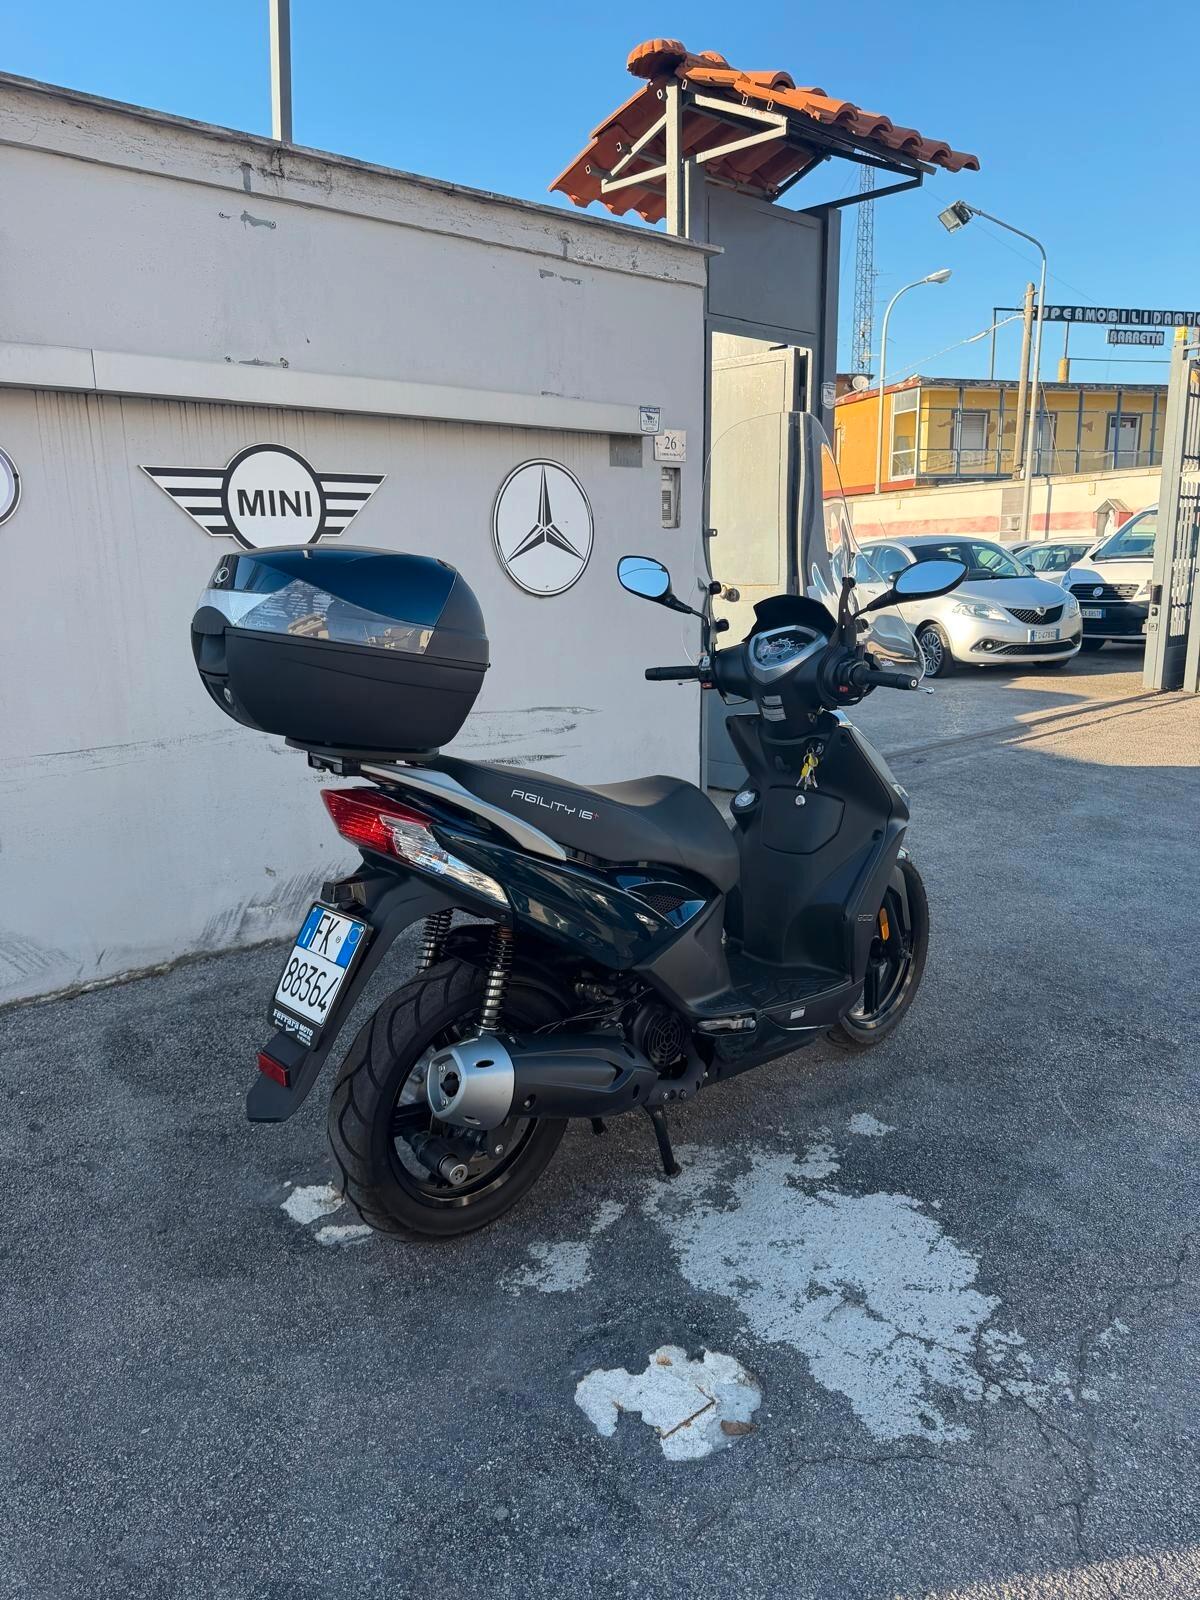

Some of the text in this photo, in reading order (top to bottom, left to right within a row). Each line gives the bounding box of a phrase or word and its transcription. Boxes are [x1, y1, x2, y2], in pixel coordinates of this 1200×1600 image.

[1110, 330, 1164, 344] BARRETTA
[664, 436, 677, 450] 26
[236, 489, 313, 517] MINI
[510, 789, 576, 815] AGILITY
[309, 913, 341, 955] FK
[281, 957, 339, 1013] 88364
[273, 1008, 300, 1030] Ferrara
[299, 1023, 314, 1037] MOTO
